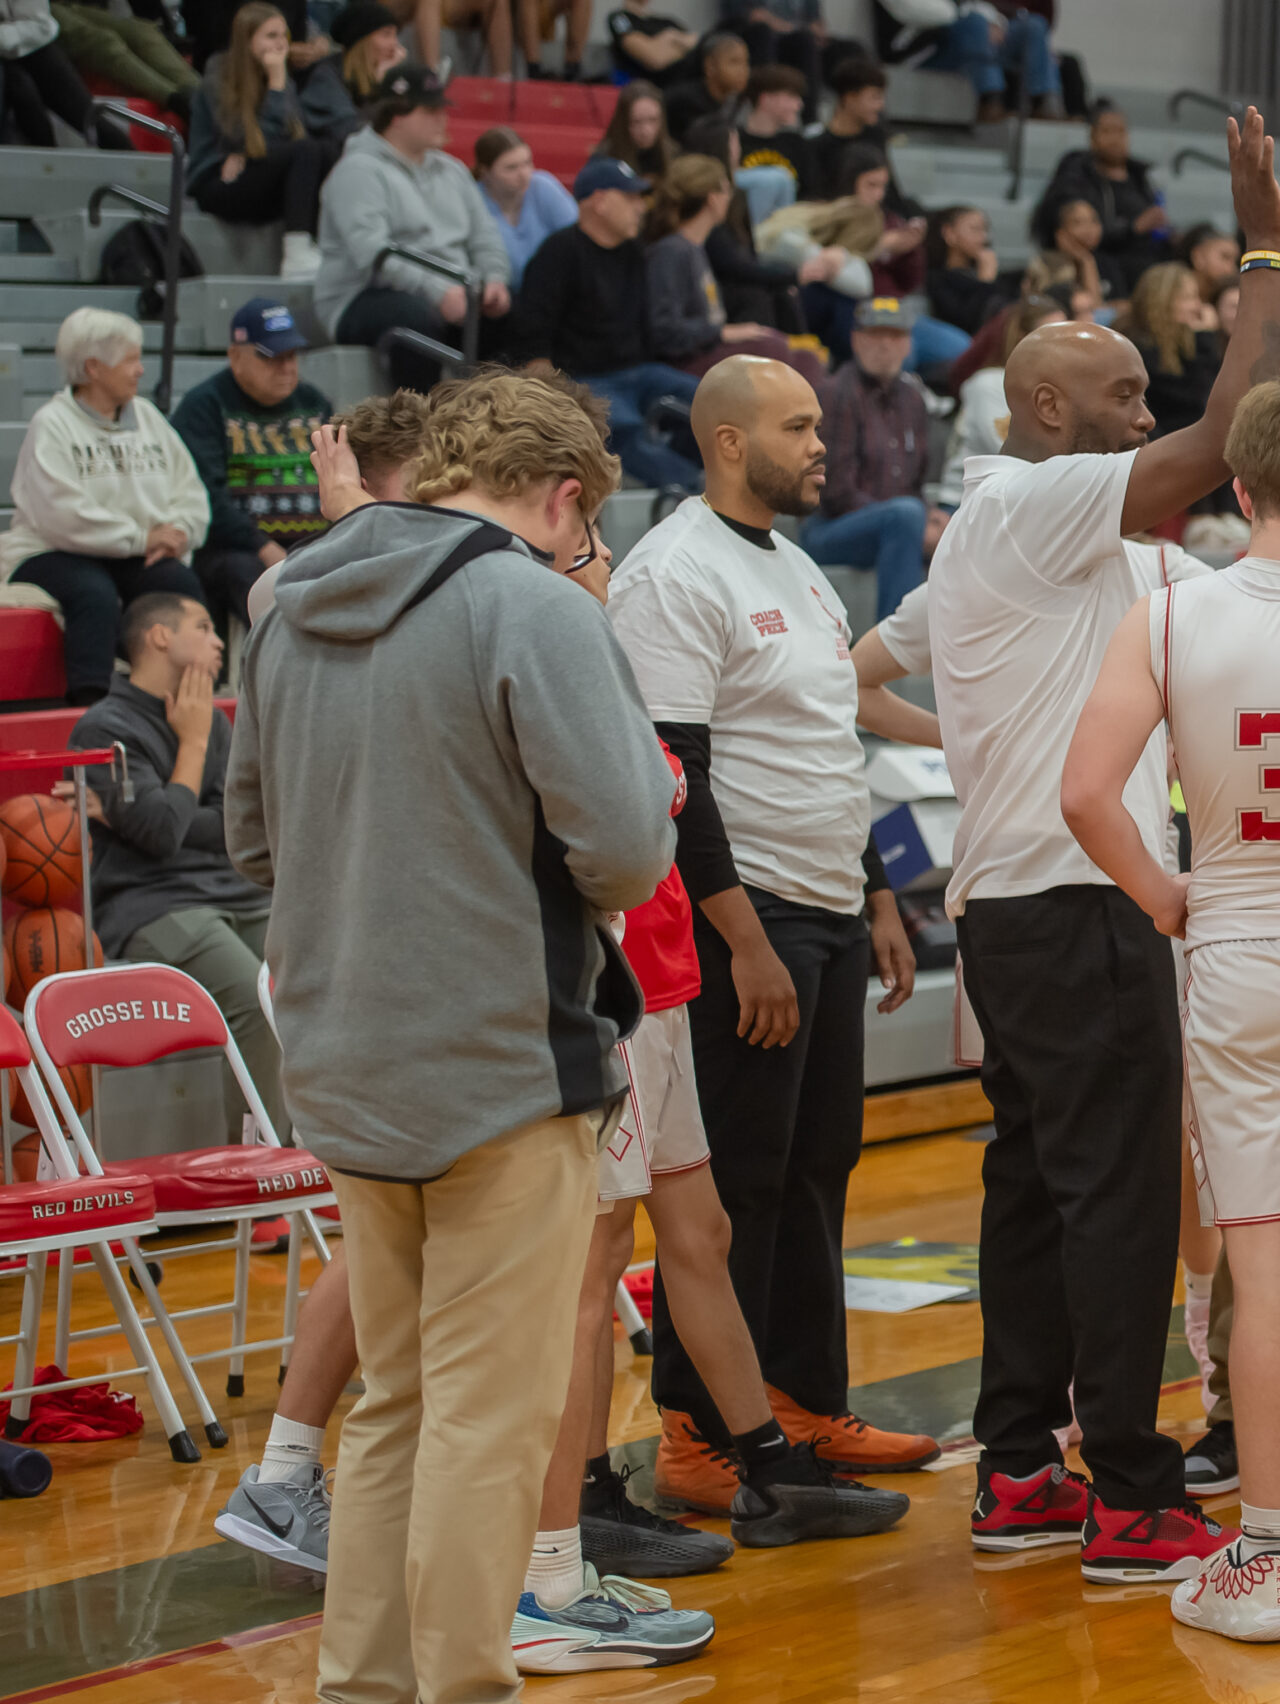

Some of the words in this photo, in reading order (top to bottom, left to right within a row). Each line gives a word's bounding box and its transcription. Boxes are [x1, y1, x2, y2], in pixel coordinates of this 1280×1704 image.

[749, 608, 784, 626] COACH
[65, 1000, 145, 1039] GROSSE
[151, 1000, 191, 1023] ILE
[32, 1202, 66, 1219] RED
[73, 1191, 135, 1212] DEVILS
